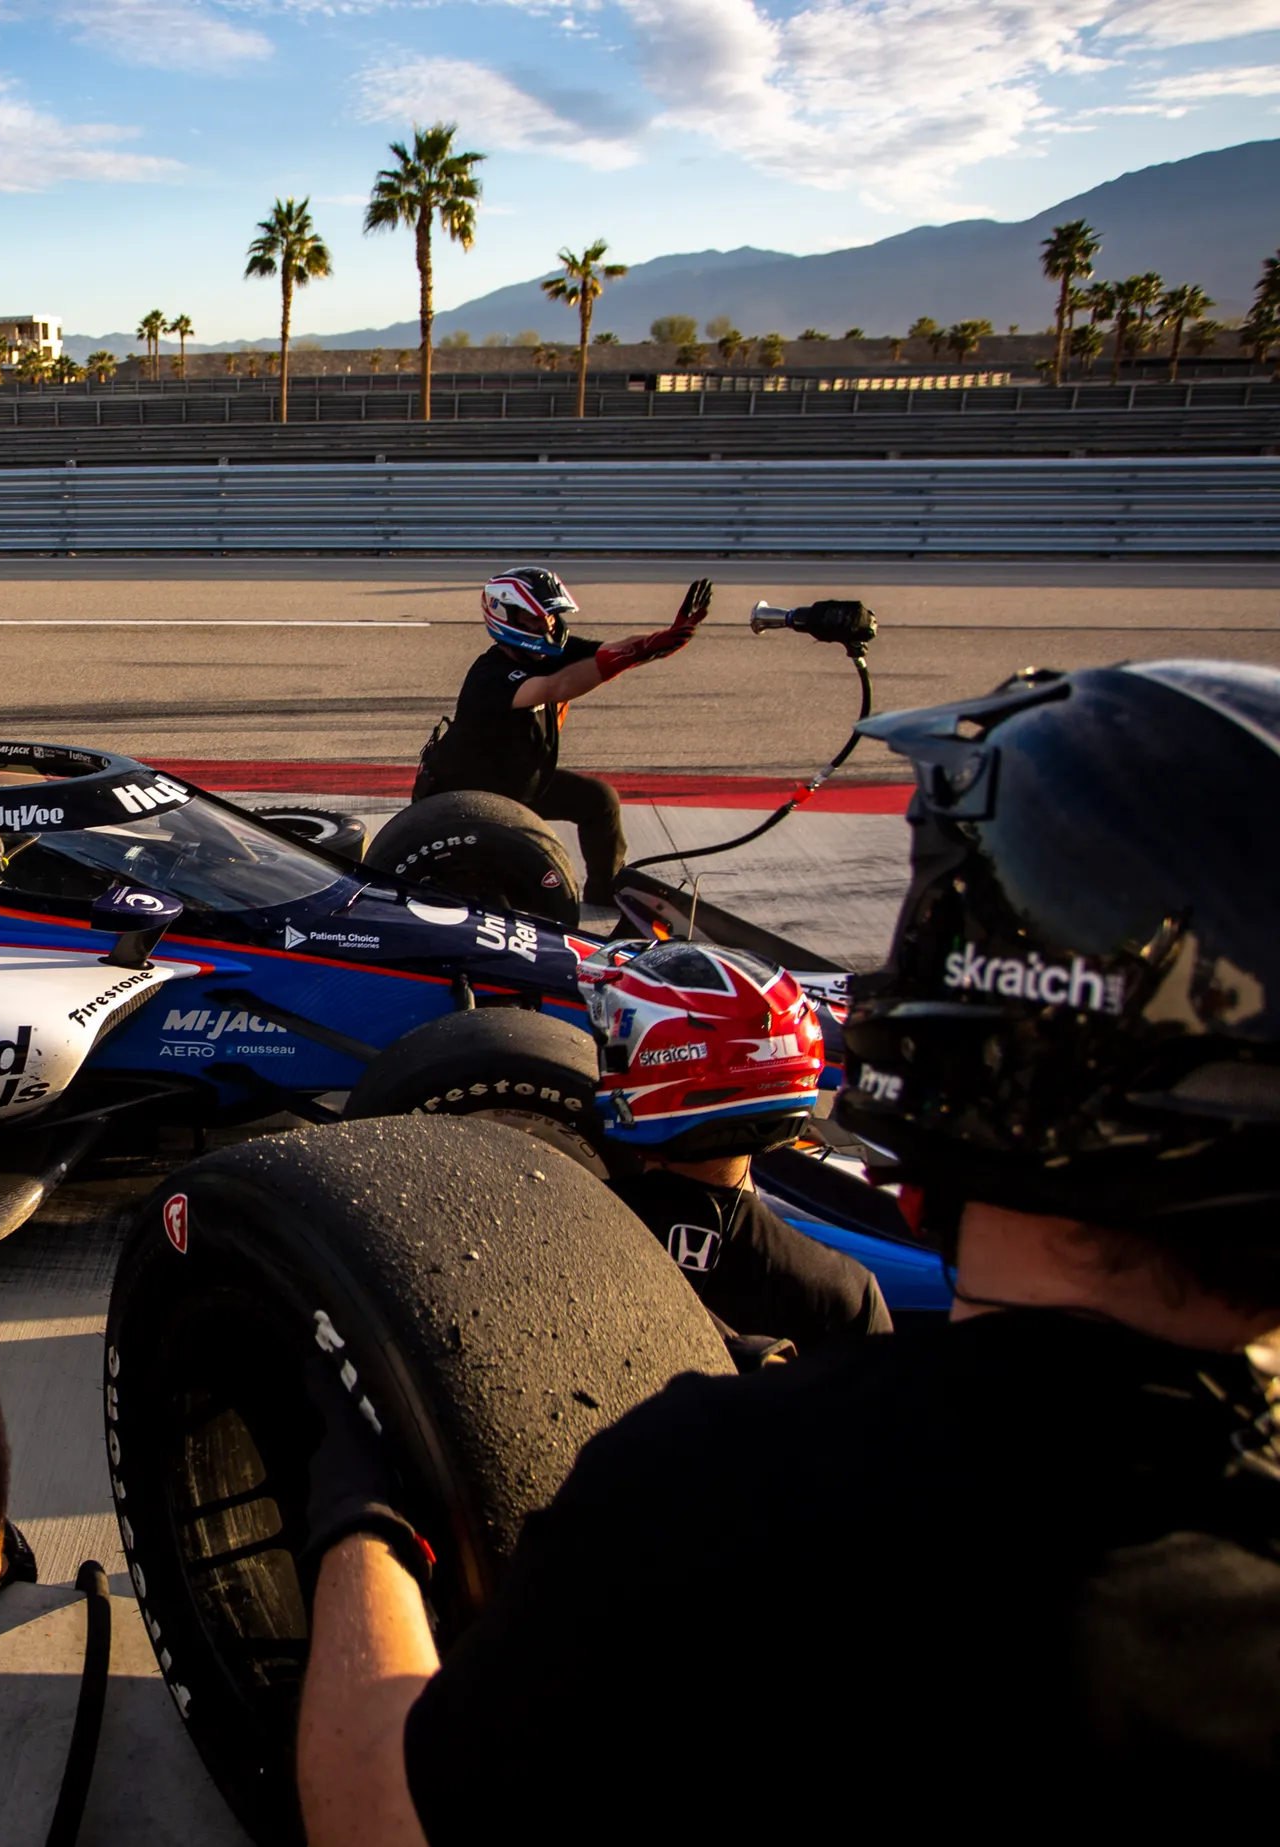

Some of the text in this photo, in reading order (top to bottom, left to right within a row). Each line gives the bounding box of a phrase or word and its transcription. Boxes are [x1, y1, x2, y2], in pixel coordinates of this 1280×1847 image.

[395, 834, 478, 875] estone
[310, 931, 380, 943] Patients Choice
[338, 941, 380, 949] Laboratories
[944, 941, 1104, 1010] skratch
[67, 969, 154, 1029] Firestone
[613, 1007, 637, 1038] 15
[159, 1045, 296, 1057] AERO rousseau
[639, 1042, 700, 1066] skratch
[412, 1078, 583, 1114] restone
